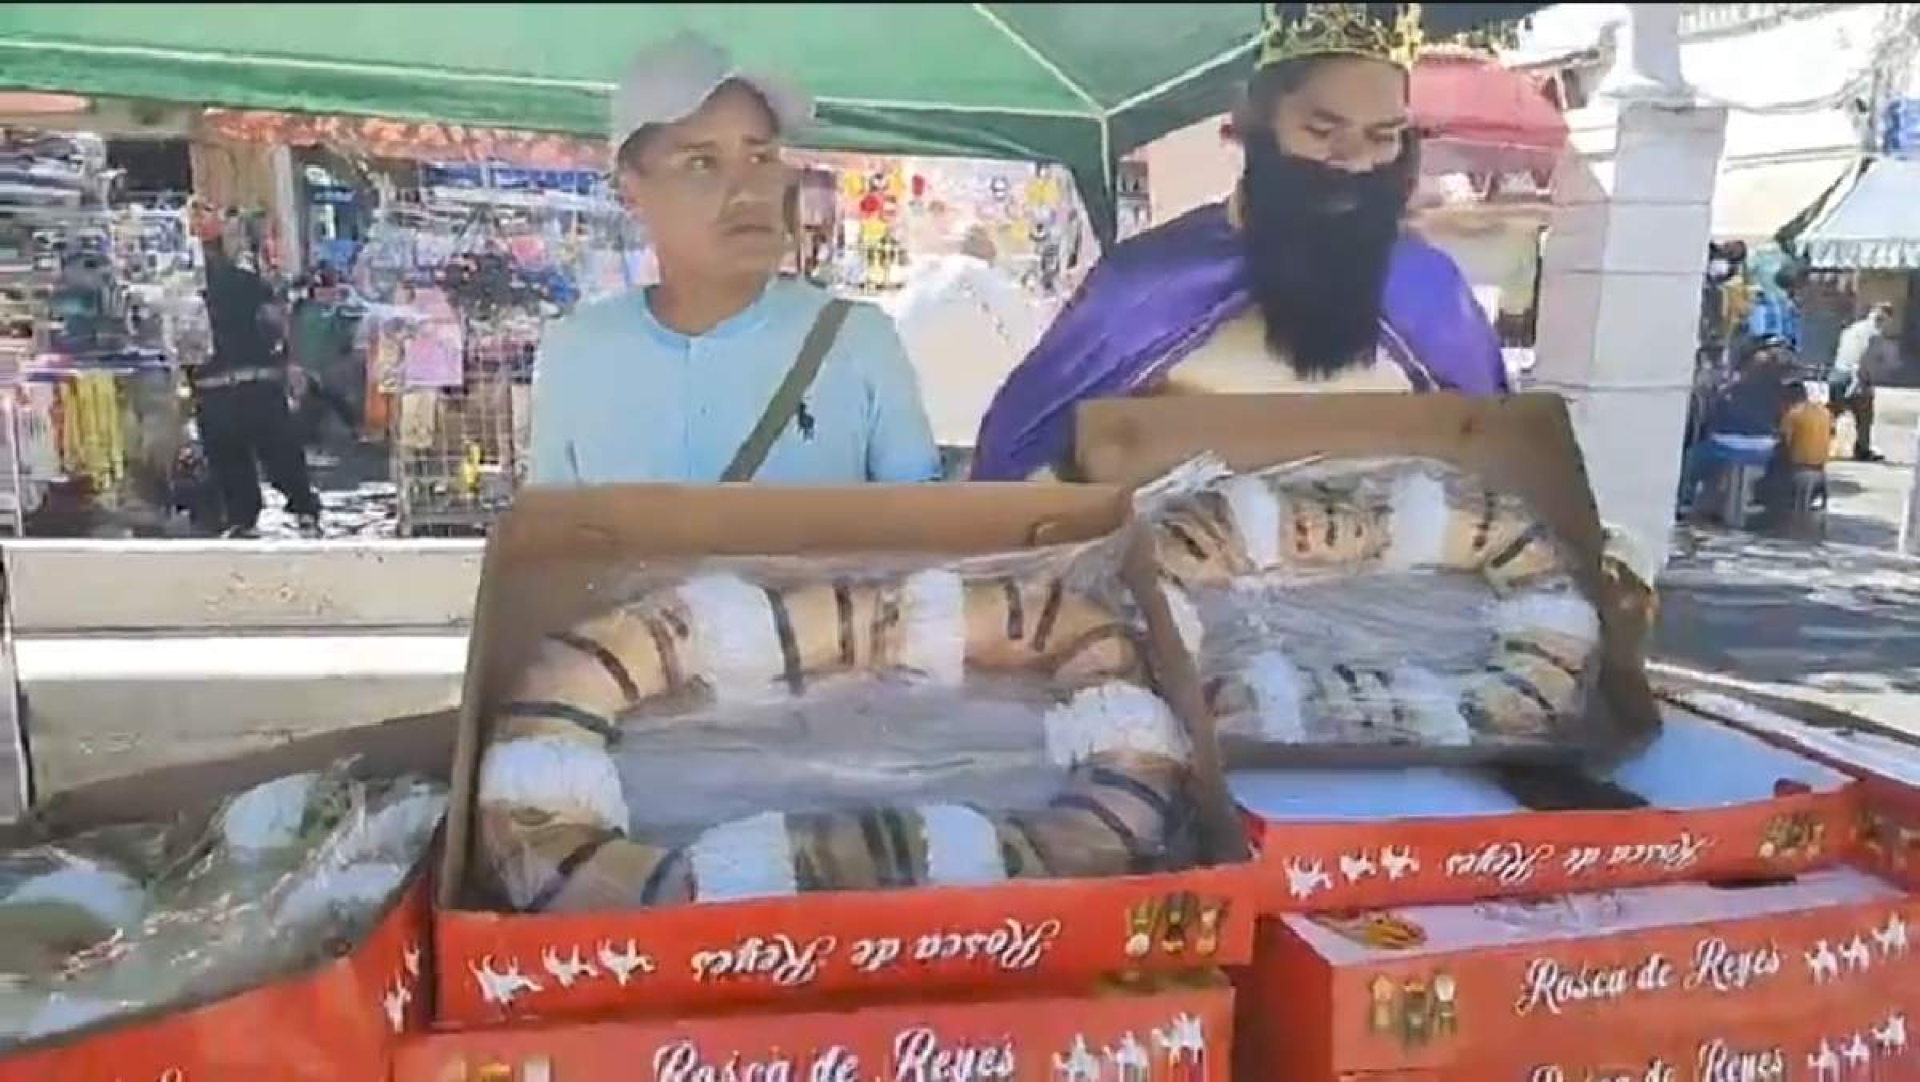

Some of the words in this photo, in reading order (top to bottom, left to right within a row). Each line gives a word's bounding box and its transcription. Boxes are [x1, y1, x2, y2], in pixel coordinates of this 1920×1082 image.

[1444, 842, 1554, 886] Reyes
[1563, 846, 1600, 874] de
[1607, 831, 1714, 871] Rosca
[692, 934, 835, 985] Reyes
[851, 938, 899, 971] de
[914, 918, 1060, 968] Rosca
[1515, 957, 1628, 1015] Rosca
[1636, 953, 1672, 989] de
[1684, 937, 1781, 989] Reyes
[810, 1046, 857, 1082] de
[889, 1027, 1014, 1082] Reyes
